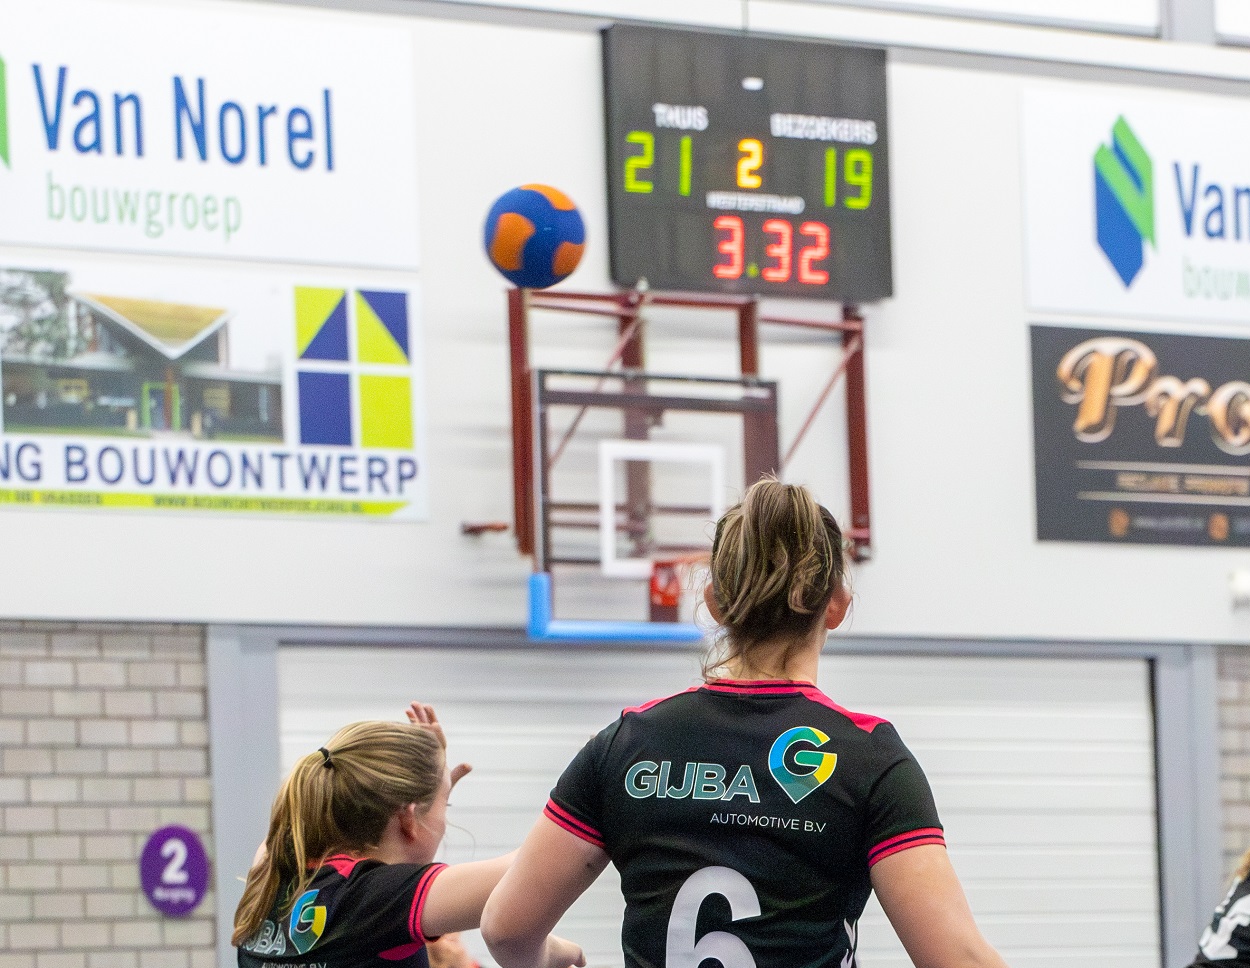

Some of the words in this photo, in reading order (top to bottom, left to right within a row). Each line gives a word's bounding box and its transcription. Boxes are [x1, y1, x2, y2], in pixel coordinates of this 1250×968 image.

[31, 63, 144, 159] Van
[172, 75, 335, 172] Norel
[652, 102, 709, 132] THUIS
[770, 112, 878, 146] BEZOEKERS
[624, 131, 693, 197] 21
[737, 138, 764, 189] 2
[823, 146, 873, 209] 19
[46, 171, 243, 242] bouwgroep
[65, 444, 420, 495] BOUWONTWERP
[624, 760, 760, 803] GIJBA
[710, 812, 800, 831] AUTOMOTIVE
[803, 821, 827, 833] B.V
[160, 838, 190, 885] 2
